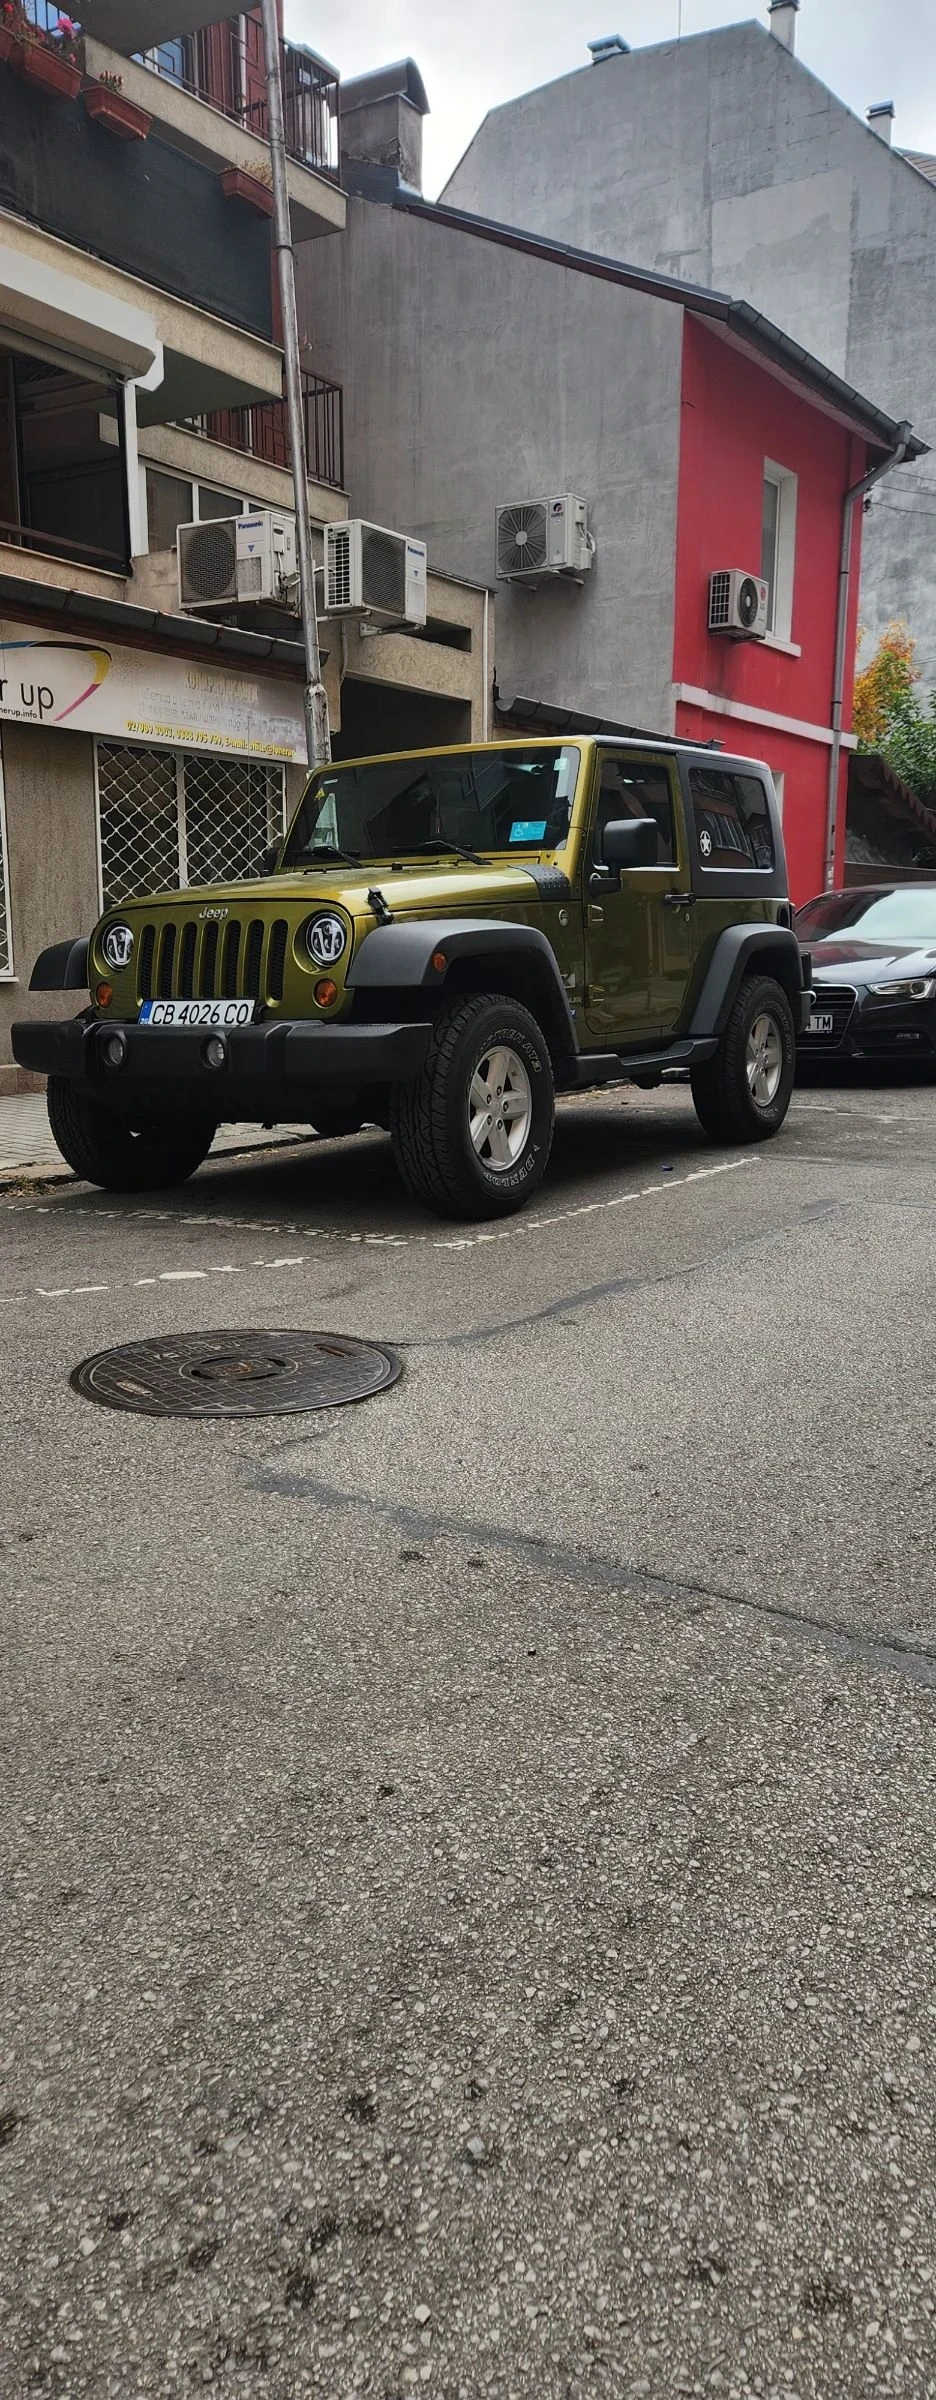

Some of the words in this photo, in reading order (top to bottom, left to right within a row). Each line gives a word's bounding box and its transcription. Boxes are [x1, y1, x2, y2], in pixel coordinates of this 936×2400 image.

[238, 521, 263, 529] Panasonic
[20, 683, 54, 720] up
[199, 906, 229, 920] Jeep
[152, 1004, 175, 1024] CB
[178, 1003, 221, 1024] 4026
[224, 1003, 249, 1024] CO
[814, 1016, 831, 1030] TM
